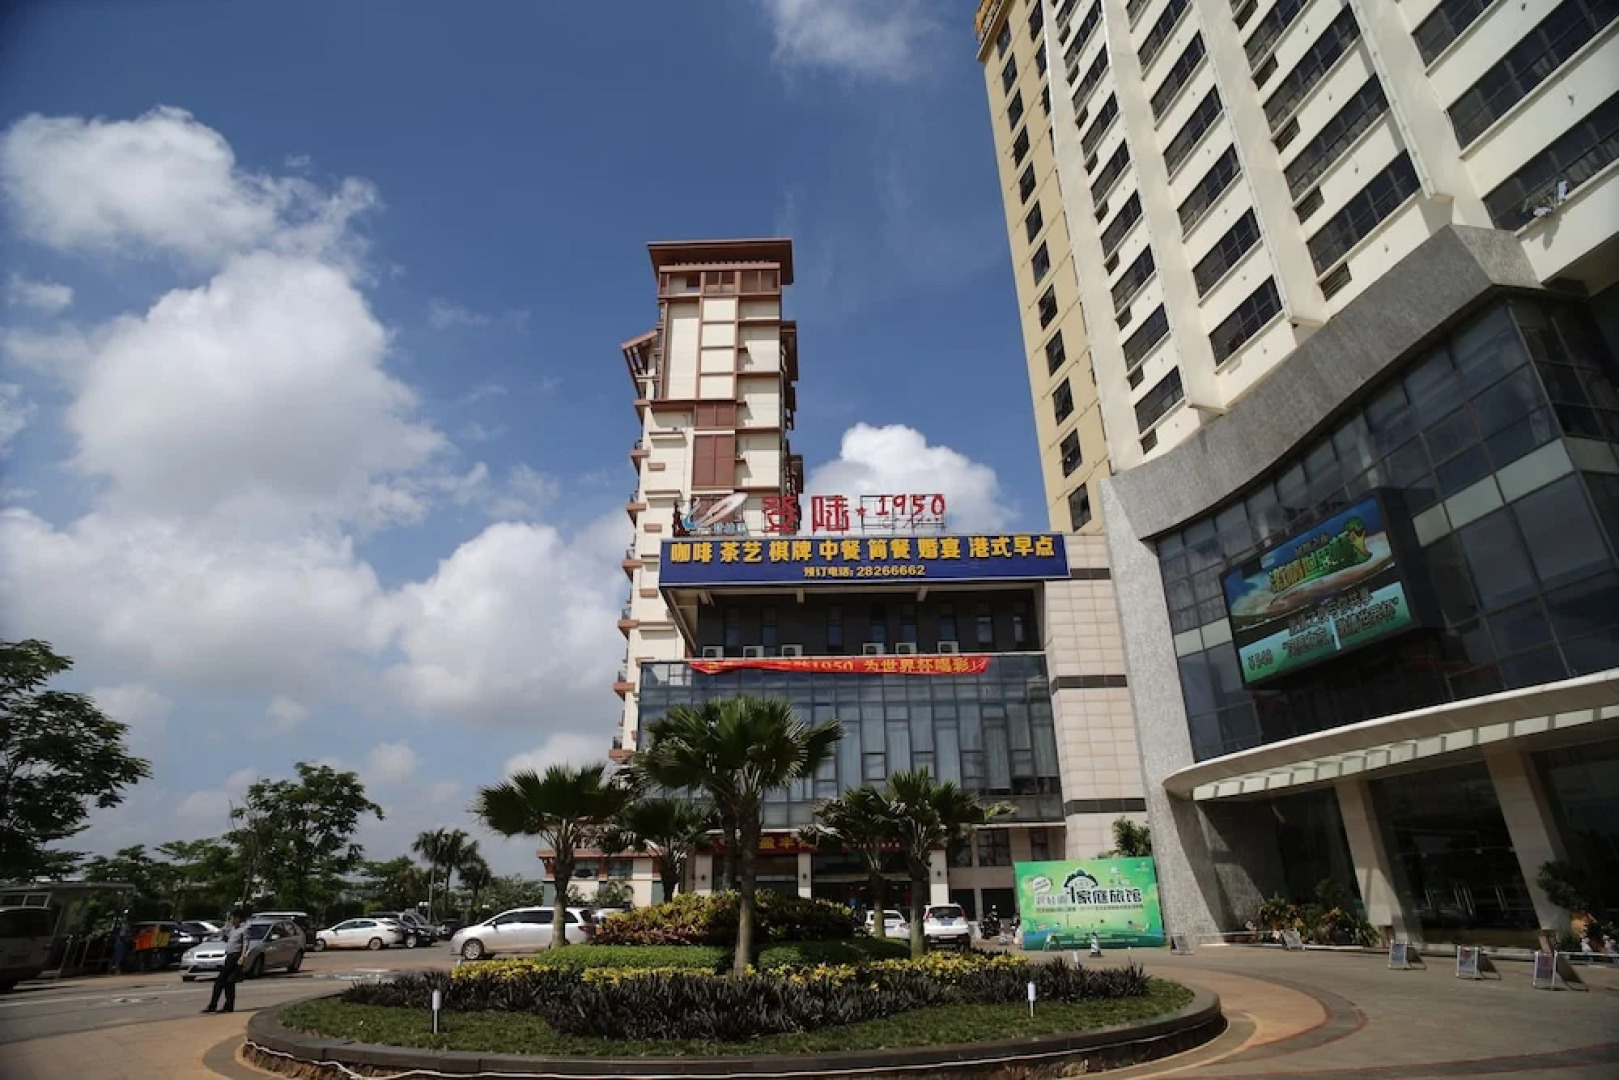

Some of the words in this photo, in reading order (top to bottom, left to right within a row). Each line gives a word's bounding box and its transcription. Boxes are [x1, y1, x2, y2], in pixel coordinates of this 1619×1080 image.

[876, 494, 946, 516] 1950
[670, 542, 713, 563] 咖啡
[720, 541, 762, 563] 茶艺
[769, 540, 812, 561] 棋牌
[819, 539, 861, 561] 中餐
[918, 537, 961, 559] 婚宴
[968, 535, 1055, 558] 港式早点
[856, 564, 926, 577] 28266662
